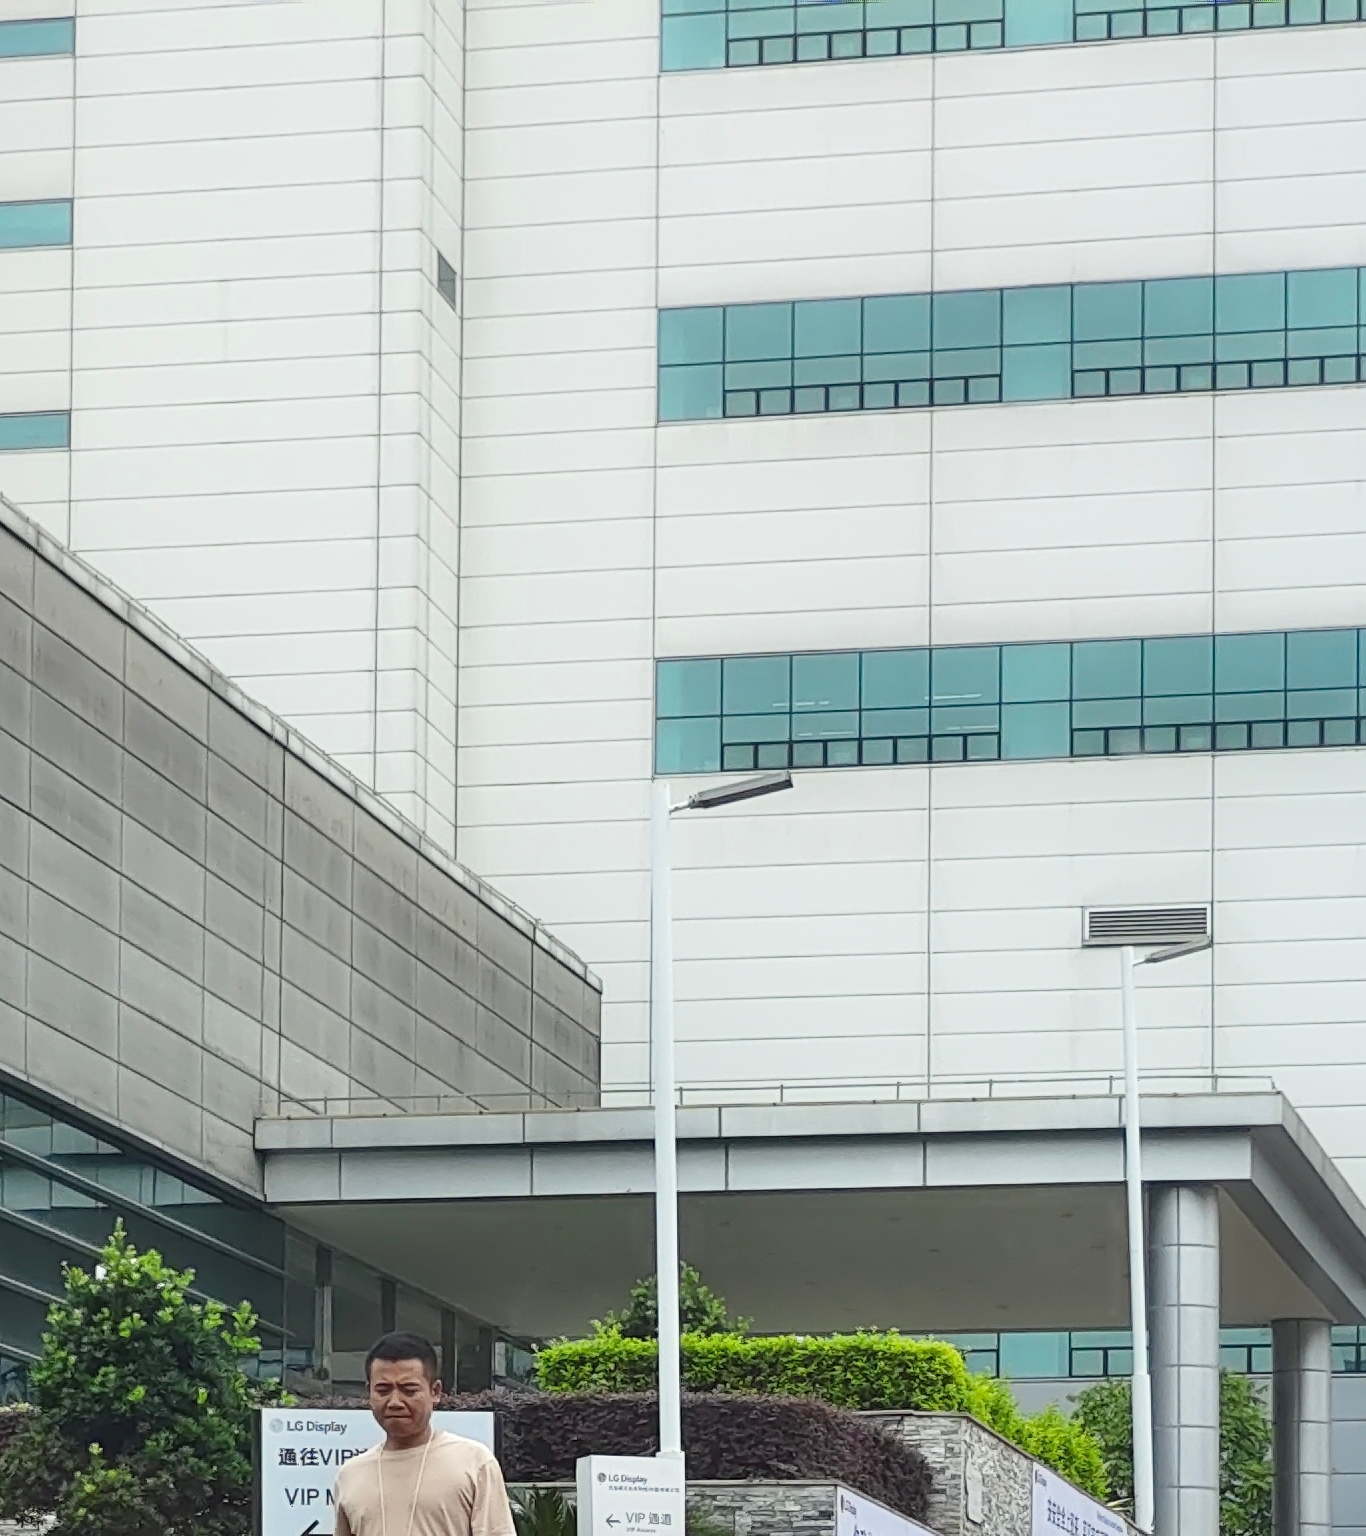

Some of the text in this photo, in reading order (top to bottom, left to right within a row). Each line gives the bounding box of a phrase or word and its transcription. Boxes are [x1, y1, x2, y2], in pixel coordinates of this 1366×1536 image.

[286, 1420, 348, 1436] LG Display
[608, 1474, 648, 1485] LG Display
[284, 1487, 320, 1506] VIP
[625, 1511, 672, 1526] VIP 通道
